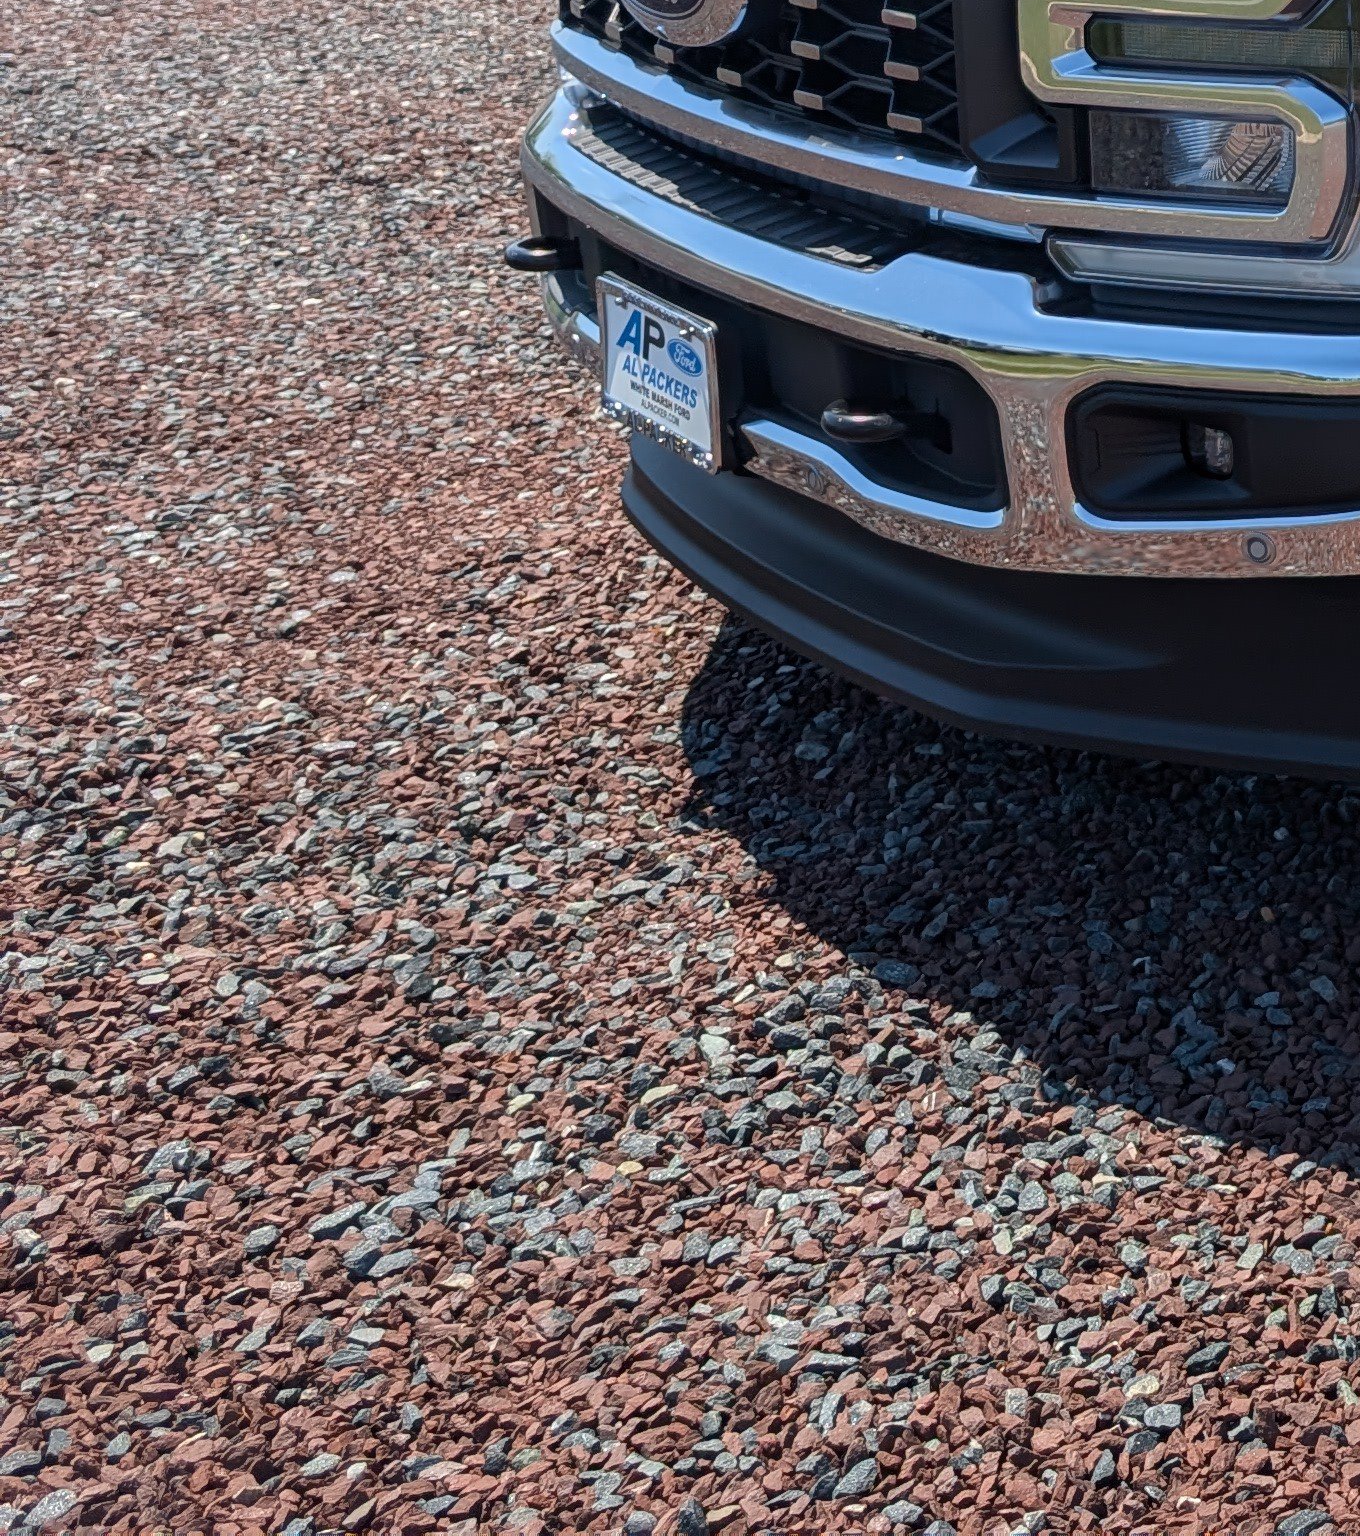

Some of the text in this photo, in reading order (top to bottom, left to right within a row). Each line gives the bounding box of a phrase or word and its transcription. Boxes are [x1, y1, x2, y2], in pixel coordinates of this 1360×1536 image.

[615, 309, 666, 362] AP
[673, 343, 697, 373] Ford
[622, 354, 698, 409] AL PACKERS
[629, 379, 691, 421] WHITE MARSH FORD
